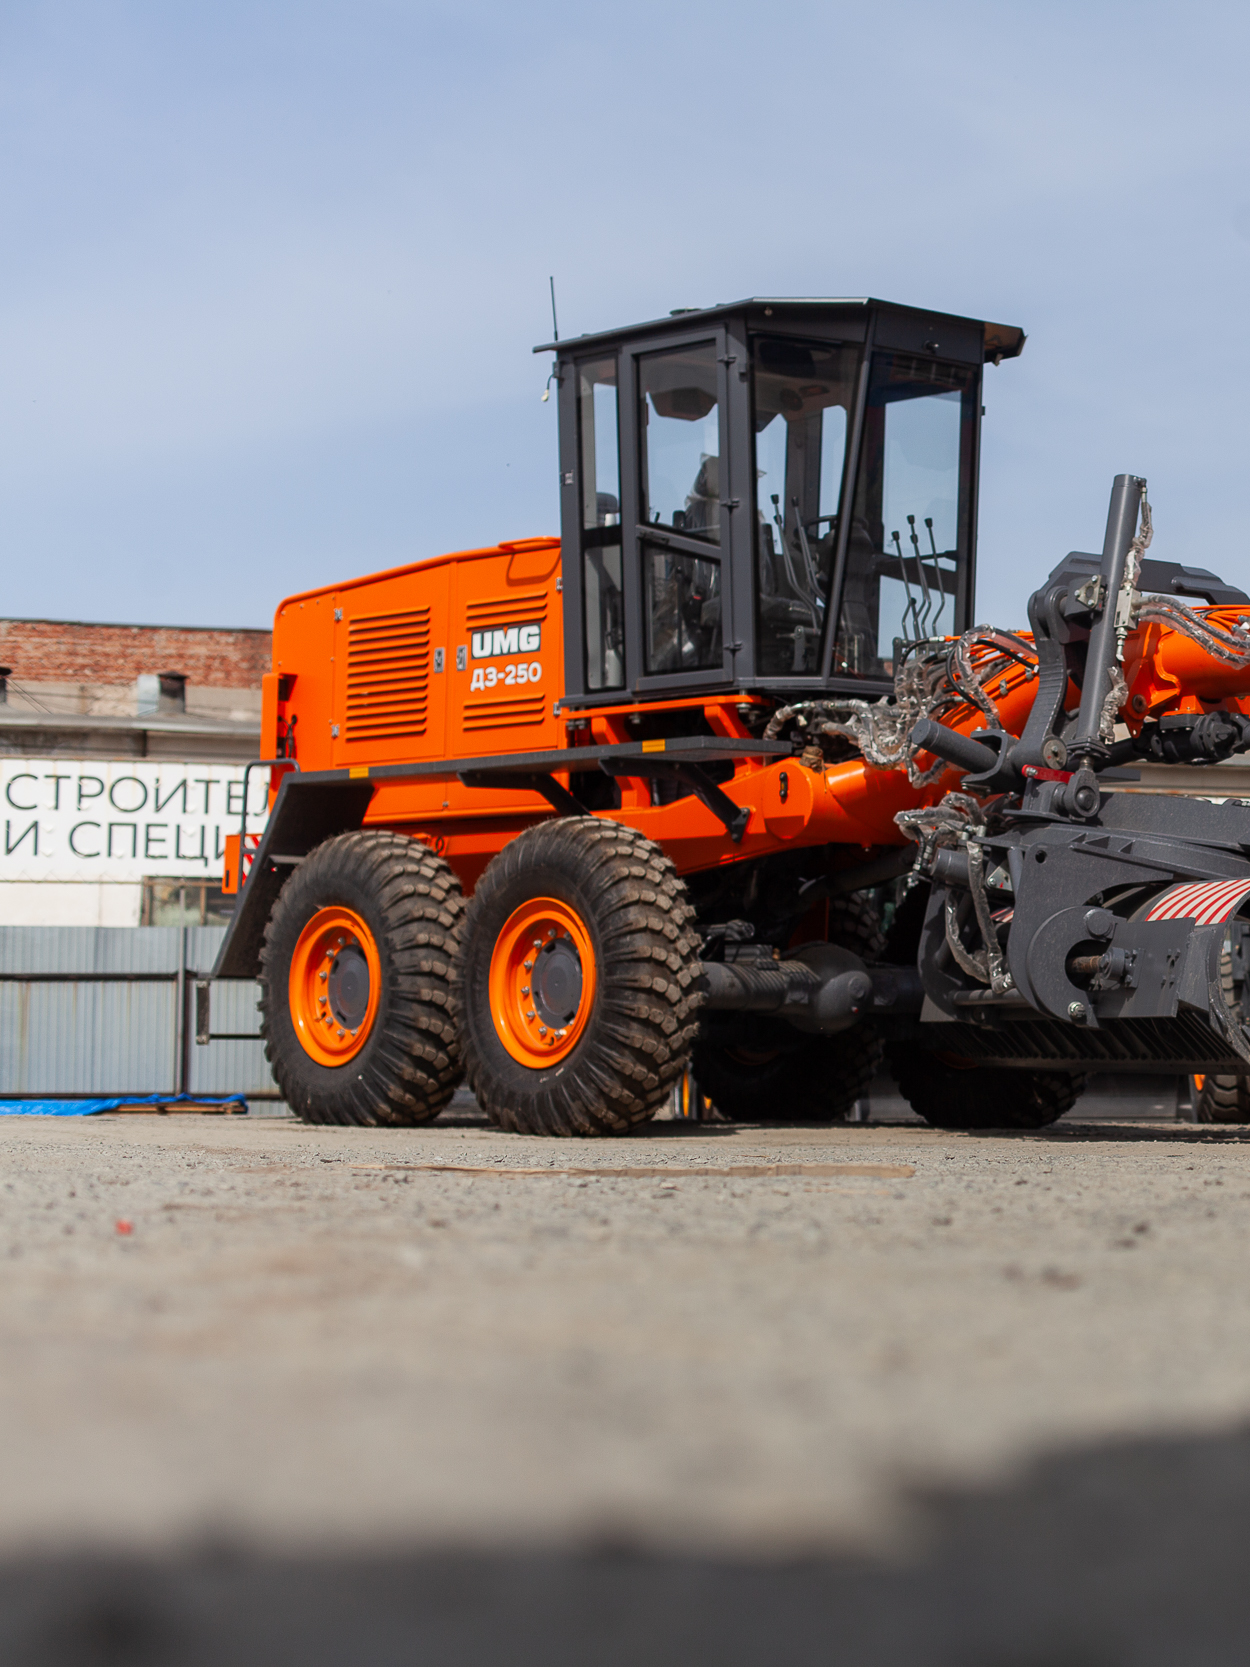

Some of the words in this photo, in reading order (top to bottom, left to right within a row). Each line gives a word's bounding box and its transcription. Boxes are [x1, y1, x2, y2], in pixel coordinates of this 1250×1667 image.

[472, 625, 540, 658] UMG
[470, 661, 542, 692] ДЗ-250
[5, 820, 38, 856] И
